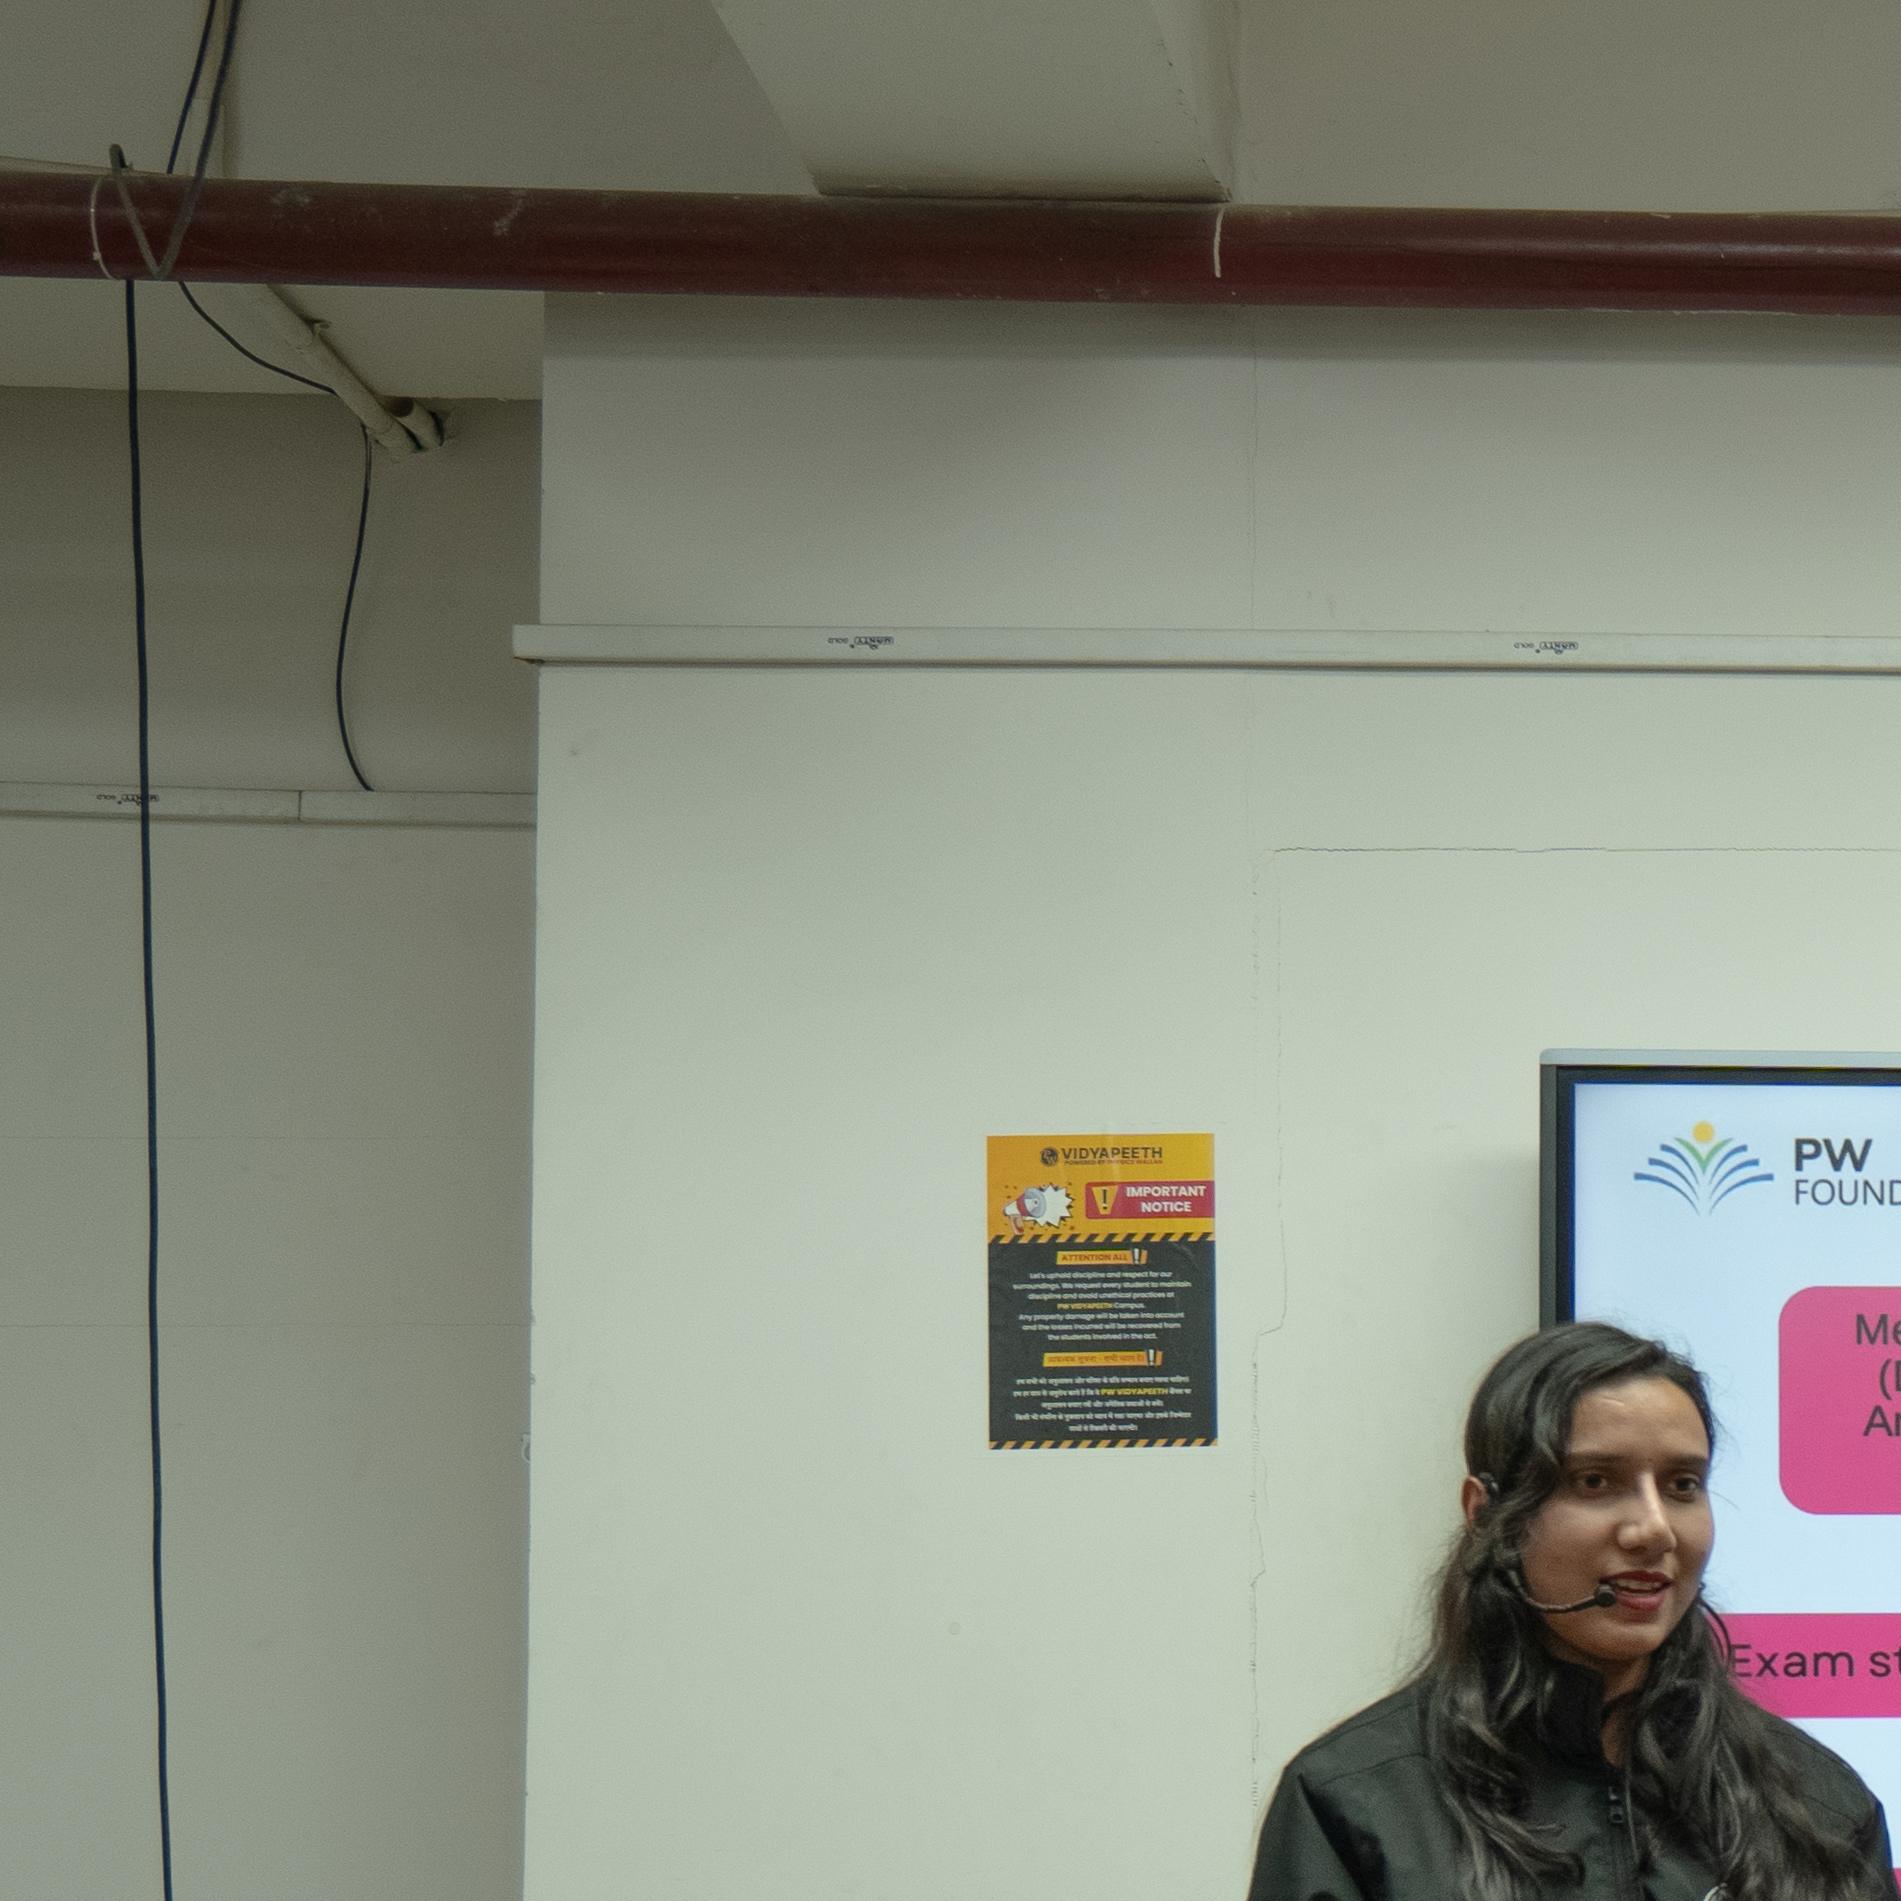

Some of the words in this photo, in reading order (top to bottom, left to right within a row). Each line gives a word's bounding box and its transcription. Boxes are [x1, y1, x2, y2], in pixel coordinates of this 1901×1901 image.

[1062, 1147, 1163, 1159] VIDYAPEETH
[1794, 1138, 1873, 1173] PW
[1126, 1185, 1206, 1198] IMPORTANT
[1141, 1202, 1192, 1213] NOTICE
[1730, 1643, 1856, 1678] Exam
